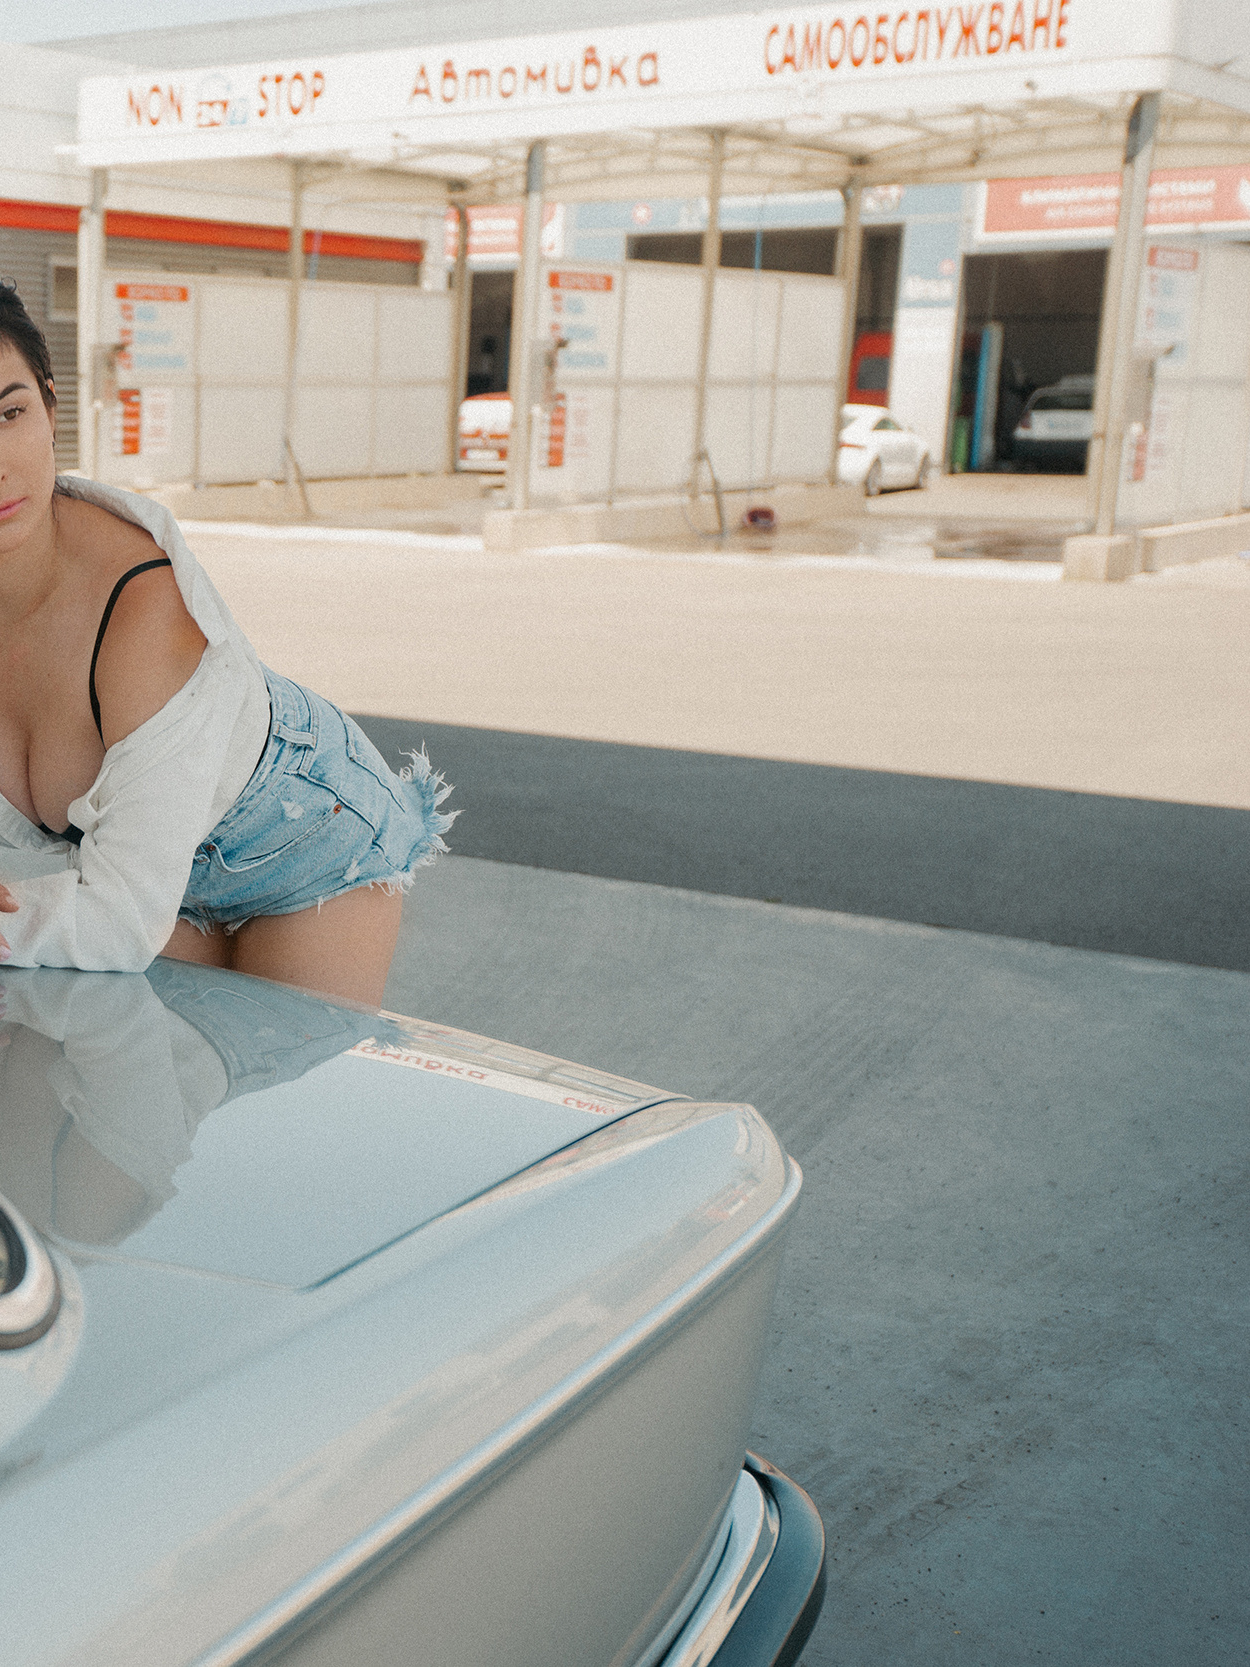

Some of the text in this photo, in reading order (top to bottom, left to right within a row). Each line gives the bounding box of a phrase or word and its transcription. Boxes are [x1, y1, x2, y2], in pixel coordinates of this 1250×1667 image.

[763, 0, 1071, 76] САМООБСЛУЖВАНЕ
[125, 69, 326, 128] NON STOP
[408, 45, 660, 104] Автомивка
